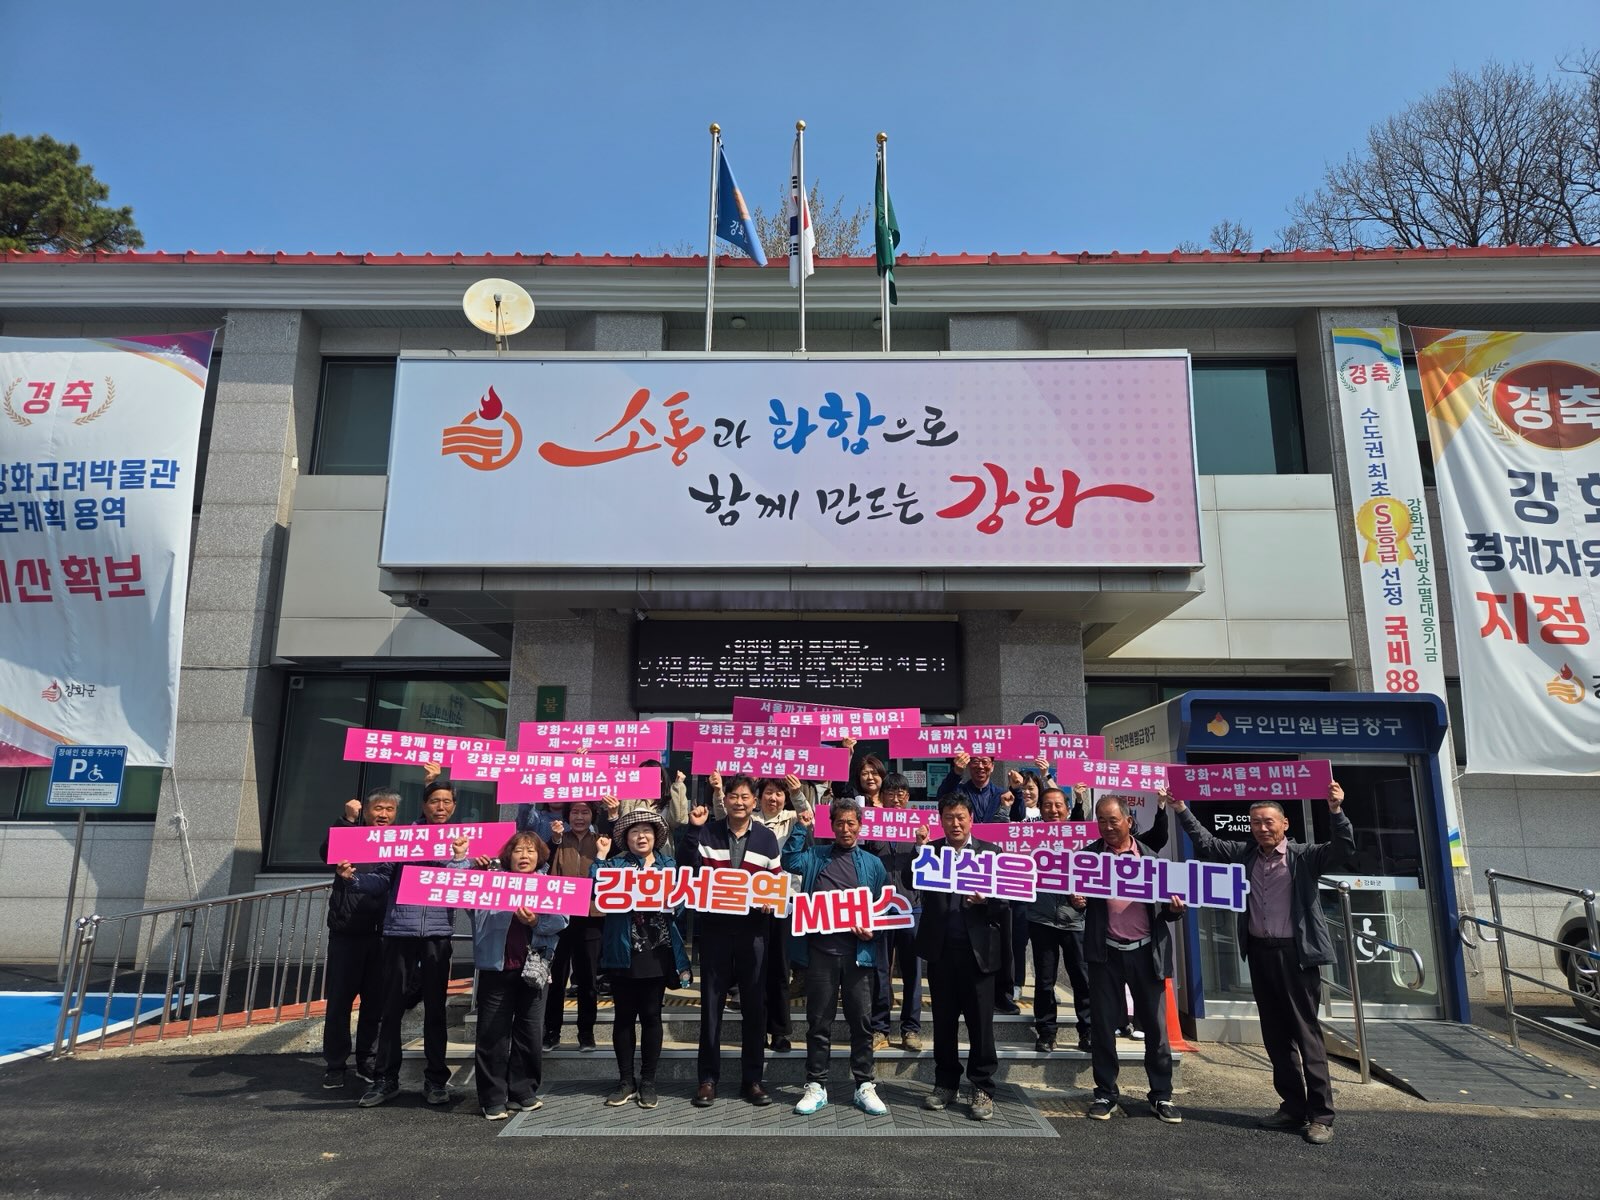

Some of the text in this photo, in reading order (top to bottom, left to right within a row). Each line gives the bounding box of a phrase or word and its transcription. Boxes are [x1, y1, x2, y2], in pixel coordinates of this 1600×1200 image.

[1349, 363, 1390, 385] 경축
[22, 380, 95, 415] 경축
[1507, 384, 1600, 430] 경축
[538, 388, 959, 467] 소통과 화합으로
[689, 462, 1154, 535] 함께 만드는 강화
[74, 497, 126, 531] 용역
[1360, 407, 1419, 693] 수도권 최초 S등급 선정 국비 88
[60, 554, 145, 601] 확보
[1407, 498, 1438, 663] 강화군 지방소멸대응기금
[1476, 591, 1590, 645] 지정
[65, 684, 96, 698] 강화군
[790, 712, 905, 725] 모두 함께 만들어요!
[1235, 717, 1403, 736] 무인민원발급창구
[537, 724, 650, 736] 강화~서울역 M버스
[699, 724, 797, 738] 강화군 교통혁신!
[918, 729, 1012, 741] 서울까지 1시간!
[366, 732, 490, 751] 모두 함께 만들어요!
[928, 742, 1002, 754] M버스 염원!
[59, 749, 124, 757] 장애인 전용 주차구역
[365, 747, 444, 763] 강화~서울역
[467, 752, 520, 766] 강화군의
[527, 754, 565, 767] 미래를
[572, 756, 596, 768] 여는
[608, 754, 636, 764] 혁신!
[733, 747, 809, 761] 강화~서울역
[69, 759, 88, 780] P
[716, 761, 825, 776] M버스 신설 기원!
[1083, 761, 1120, 774] 강화군
[1185, 765, 1311, 781] 강화~서울역 M버스
[520, 773, 561, 785] 서울역
[569, 772, 607, 783] M버스
[614, 770, 641, 782] 신설
[1096, 775, 1132, 787] M버스
[543, 786, 617, 799] 응원합니다!
[1199, 783, 1297, 796] 제~~발~~요!!
[883, 811, 920, 823] M버스
[928, 813, 940, 825] 신
[366, 827, 482, 843] 서울까지 1시간!
[1008, 825, 1087, 838] 강화~서울역
[379, 844, 424, 858] M버스
[419, 870, 576, 894] 강화군의 미래를 여는
[428, 888, 562, 910] 교통혁신! M버스!
[794, 887, 912, 934] M버스
